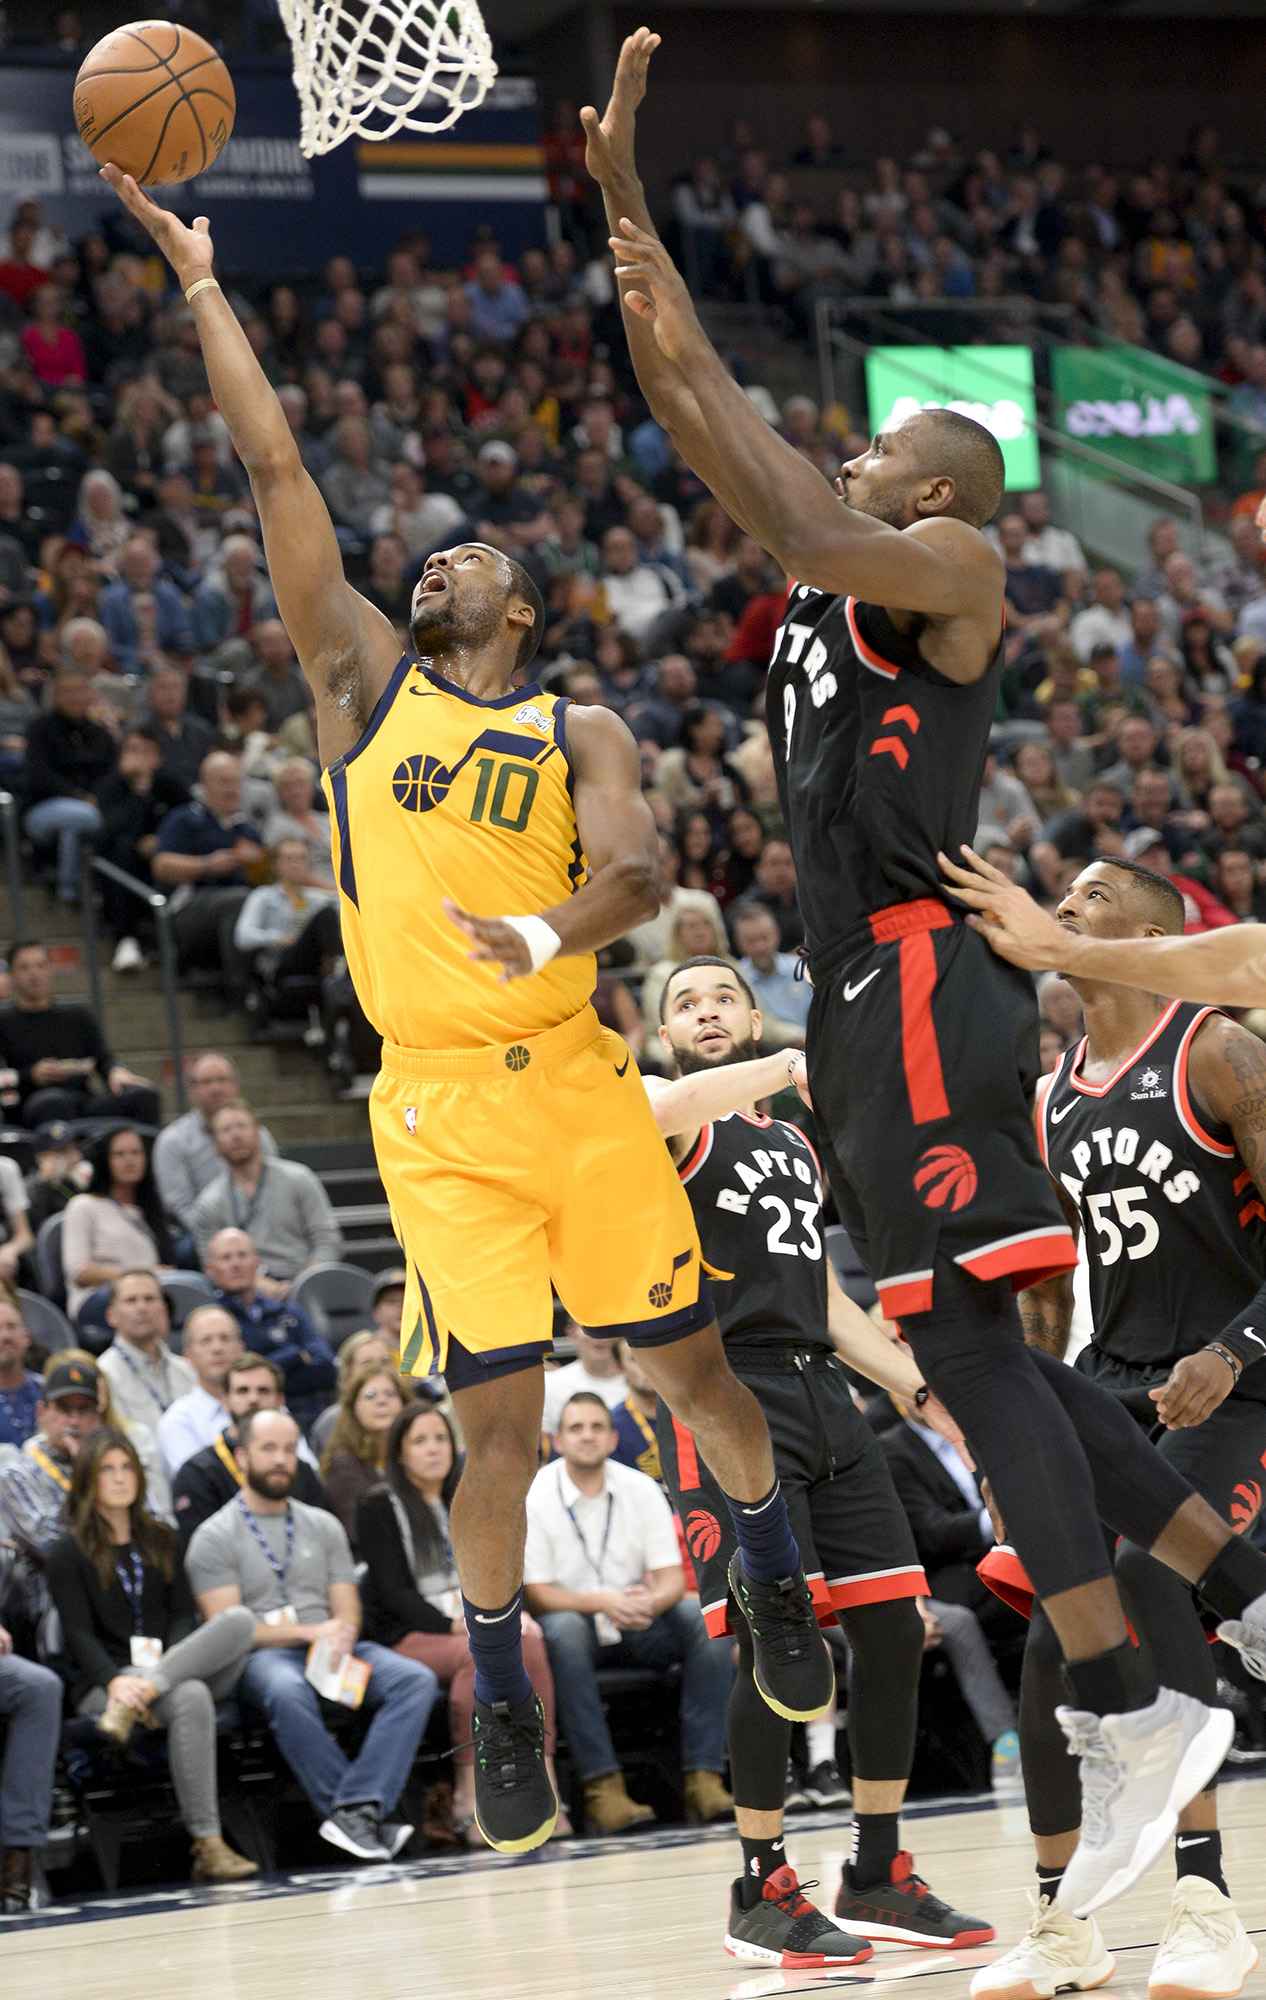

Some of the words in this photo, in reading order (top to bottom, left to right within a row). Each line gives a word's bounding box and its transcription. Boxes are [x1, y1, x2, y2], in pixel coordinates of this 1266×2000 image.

[469, 757, 540, 833] 10
[1131, 1091, 1149, 1100] Sun
[1150, 1088, 1168, 1099] Life
[1061, 1127, 1201, 1206] APTORS
[758, 1195, 823, 1261] 23
[1086, 1185, 1160, 1266] 55
